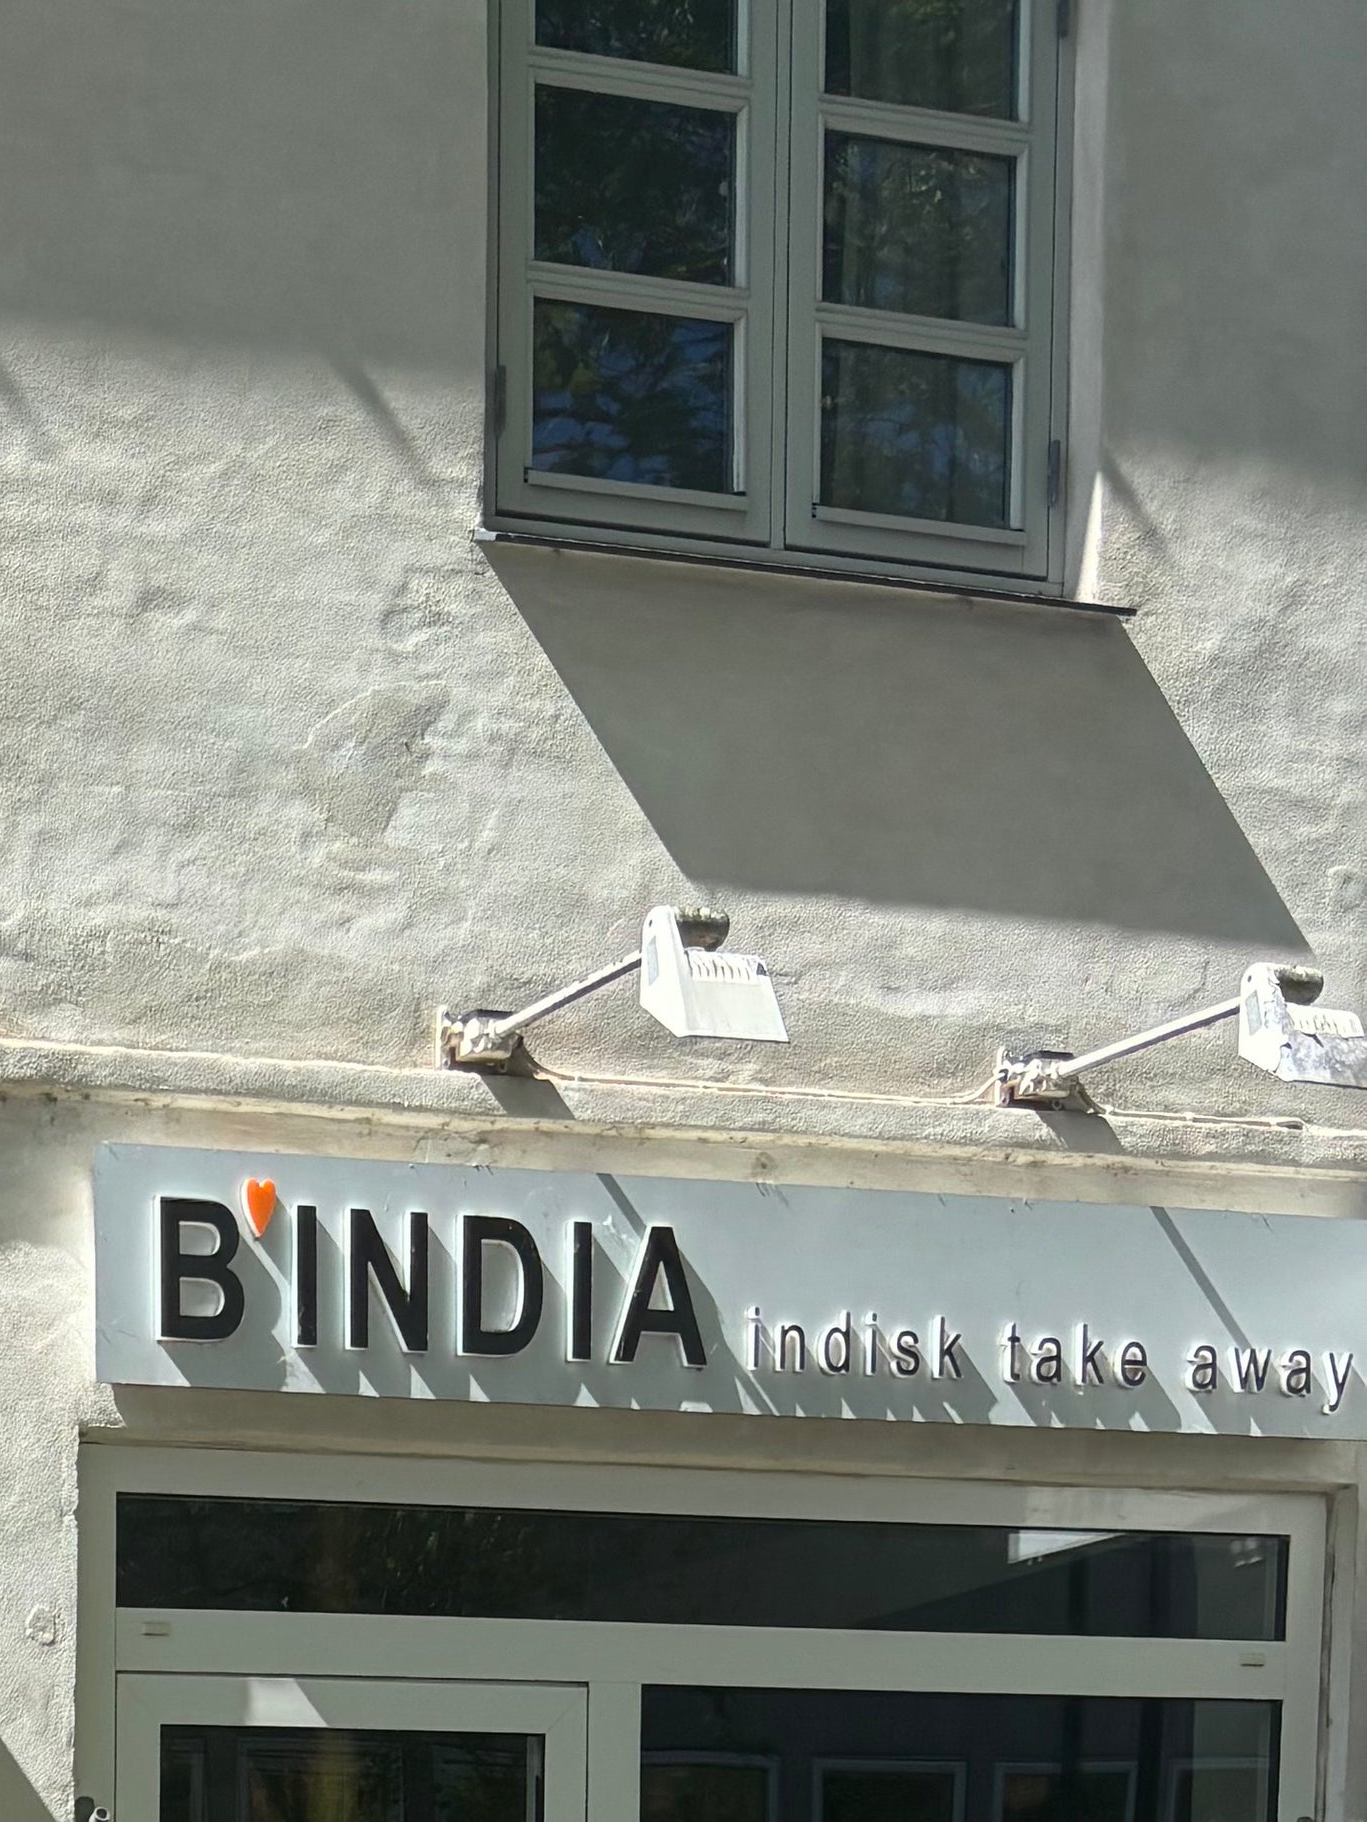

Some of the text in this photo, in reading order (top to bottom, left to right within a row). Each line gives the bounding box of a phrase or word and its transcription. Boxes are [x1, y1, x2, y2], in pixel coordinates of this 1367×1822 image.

[747, 1306, 1354, 1417] indisk take away
